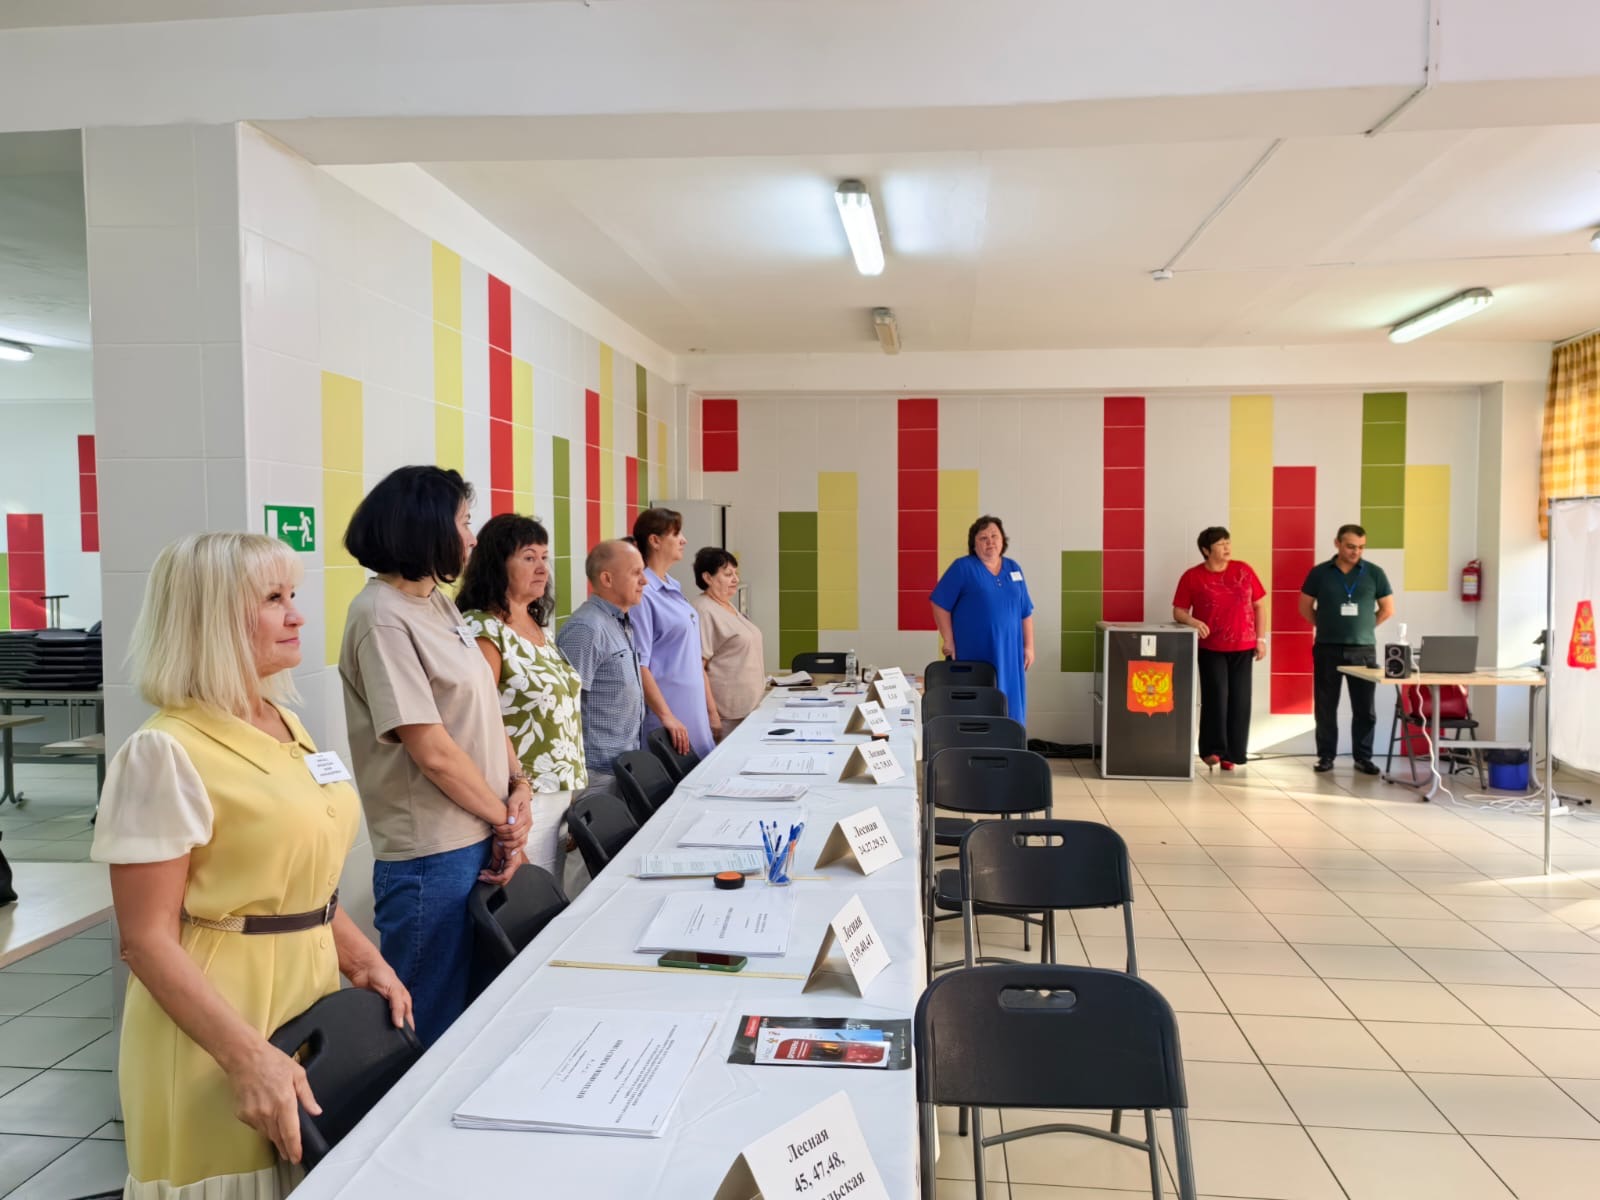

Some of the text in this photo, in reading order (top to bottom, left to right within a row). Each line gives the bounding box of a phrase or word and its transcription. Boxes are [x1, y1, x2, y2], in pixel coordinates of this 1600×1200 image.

[853, 821, 878, 838] Лесная
[842, 915, 863, 943] Лесная
[787, 1128, 829, 1163] Лесная
